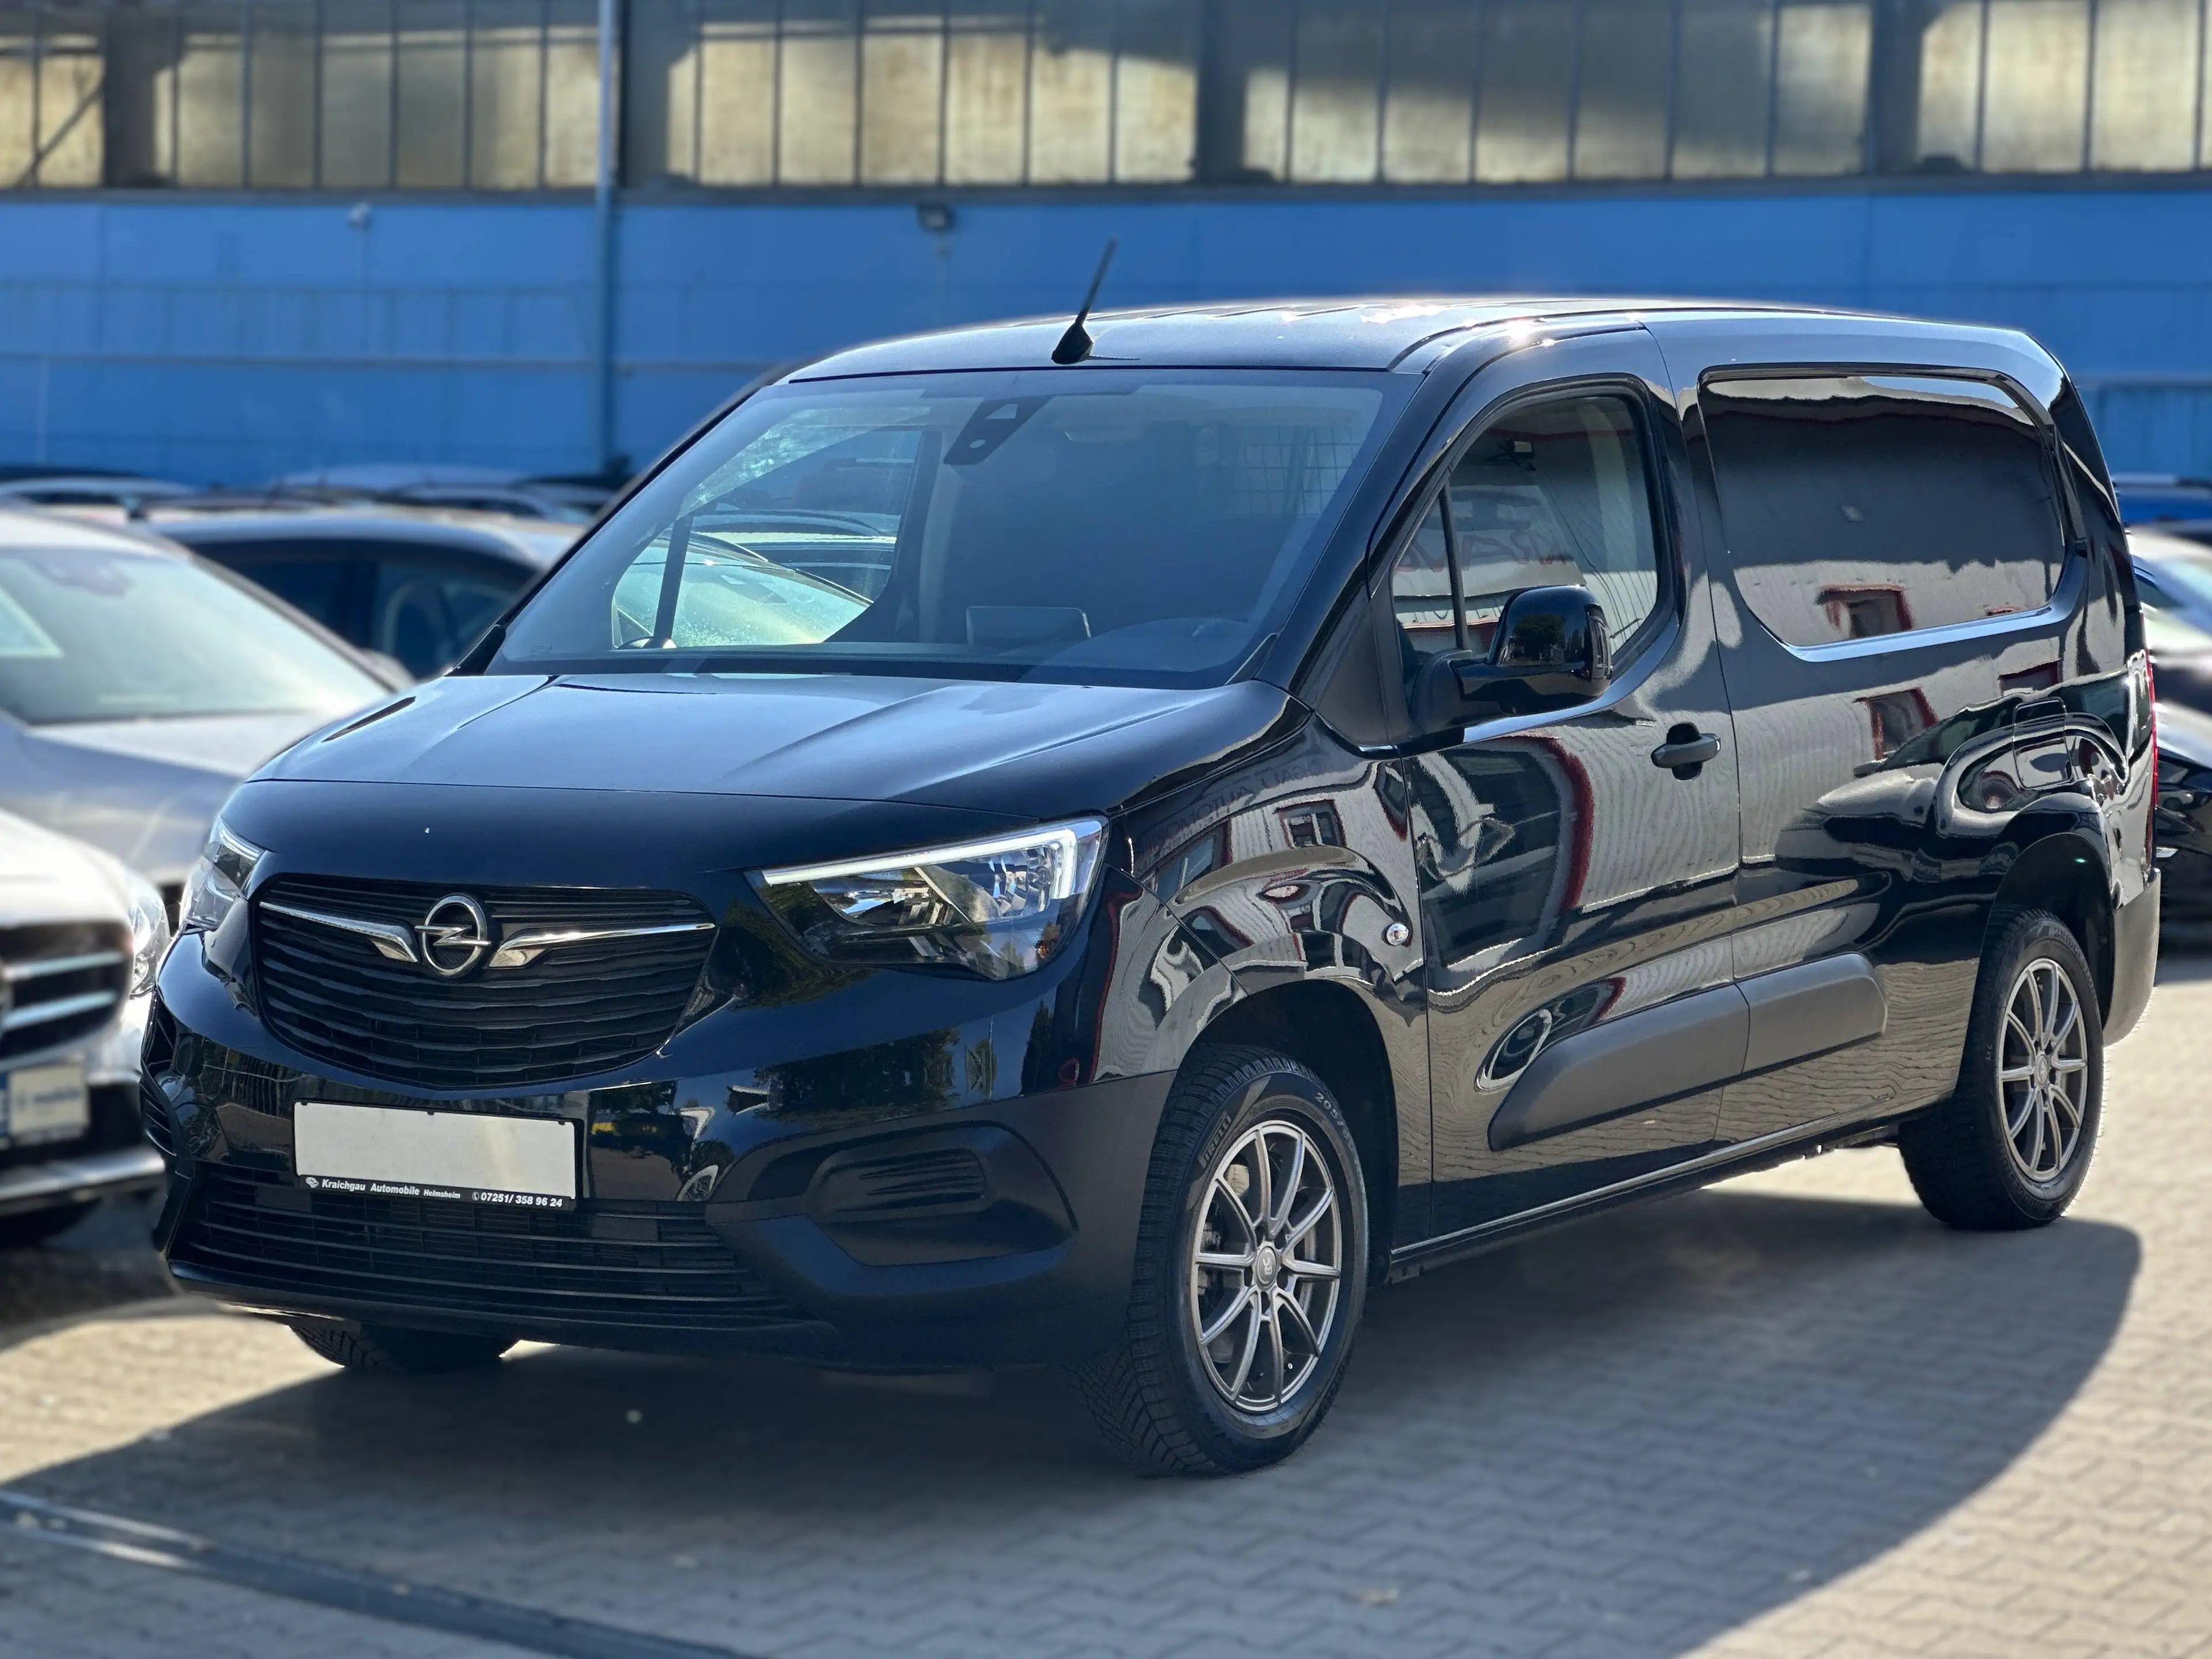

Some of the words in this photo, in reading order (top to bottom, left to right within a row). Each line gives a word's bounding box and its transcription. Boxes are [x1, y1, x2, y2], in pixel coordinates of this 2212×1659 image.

[322, 1179, 365, 1192] Kraichgau
[370, 1183, 420, 1196] Automobile
[424, 1189, 460, 1200] Helmsheim
[481, 1192, 514, 1203] 07251/
[515, 1195, 534, 1205] 358
[535, 1197, 548, 1206] 96
[550, 1198, 563, 1207] 24
